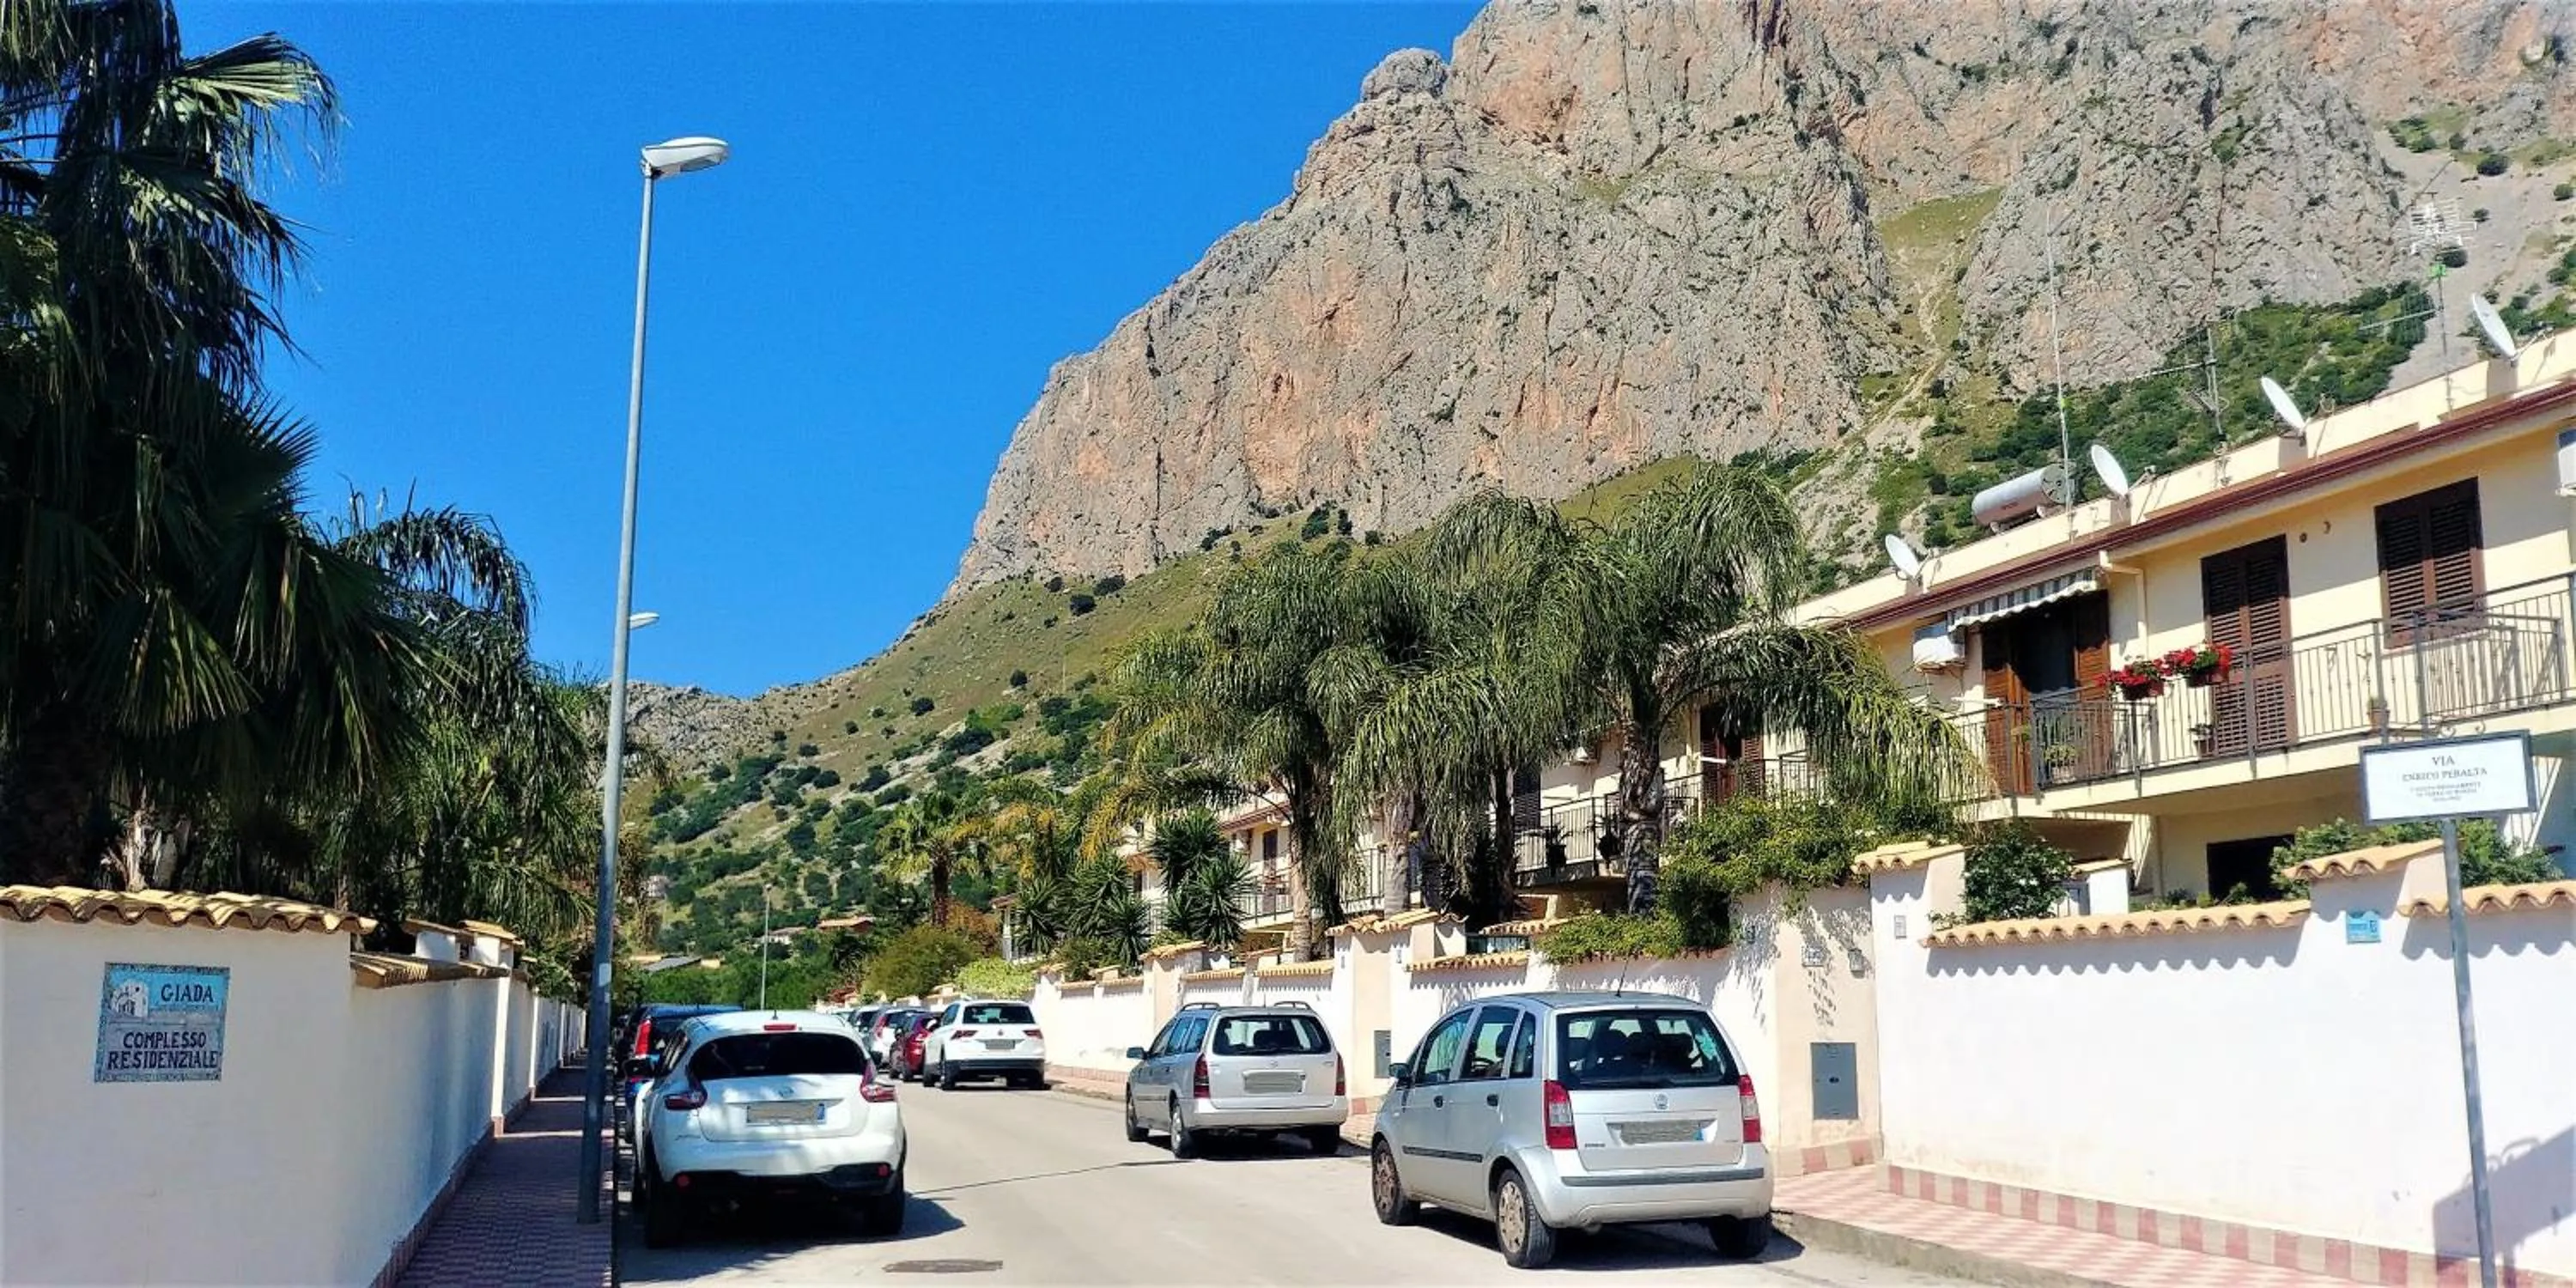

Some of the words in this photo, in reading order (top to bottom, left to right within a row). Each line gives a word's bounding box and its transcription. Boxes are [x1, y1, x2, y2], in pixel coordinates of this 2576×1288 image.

[2432, 755, 2456, 766] VIA
[161, 983, 214, 1002] GIADA
[123, 1031, 207, 1049] COMPLESSO
[107, 1050, 219, 1070] RESIDENZIALE
